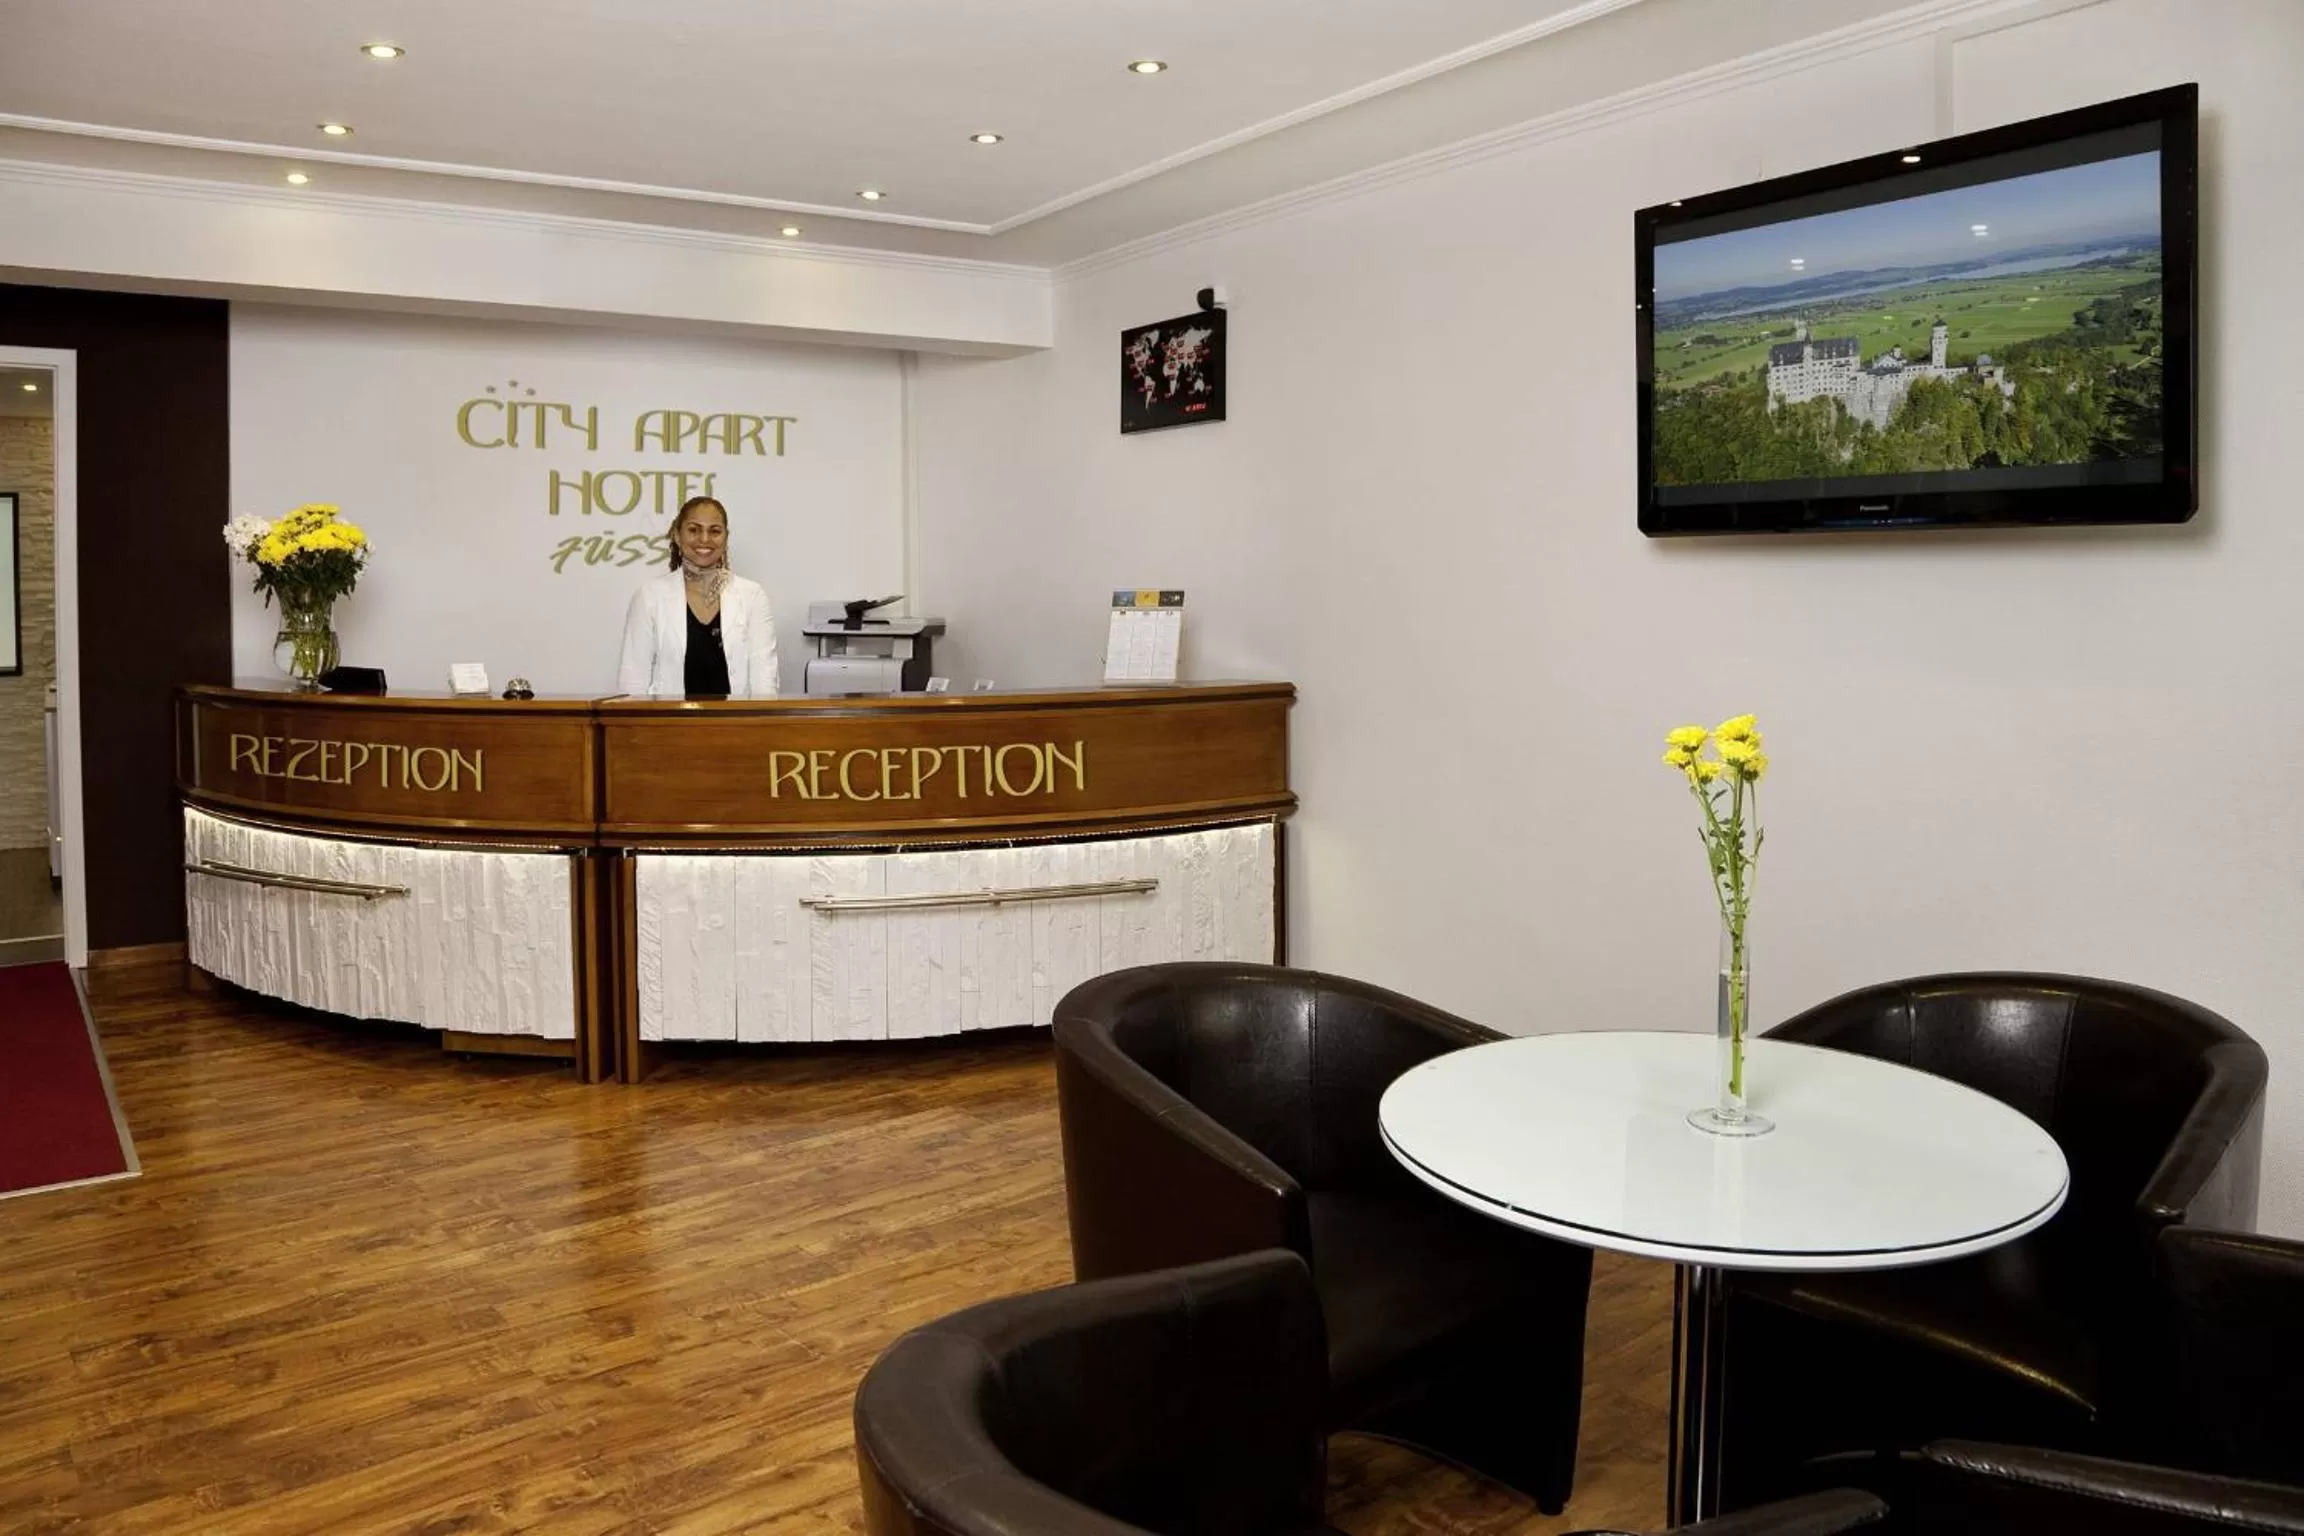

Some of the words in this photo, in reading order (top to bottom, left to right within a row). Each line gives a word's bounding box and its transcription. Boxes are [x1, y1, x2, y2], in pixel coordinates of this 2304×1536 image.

[457, 398, 597, 450] CITY
[635, 409, 798, 457] APART
[230, 734, 483, 792] REZEPTION
[769, 741, 1084, 801] RECEPTION
